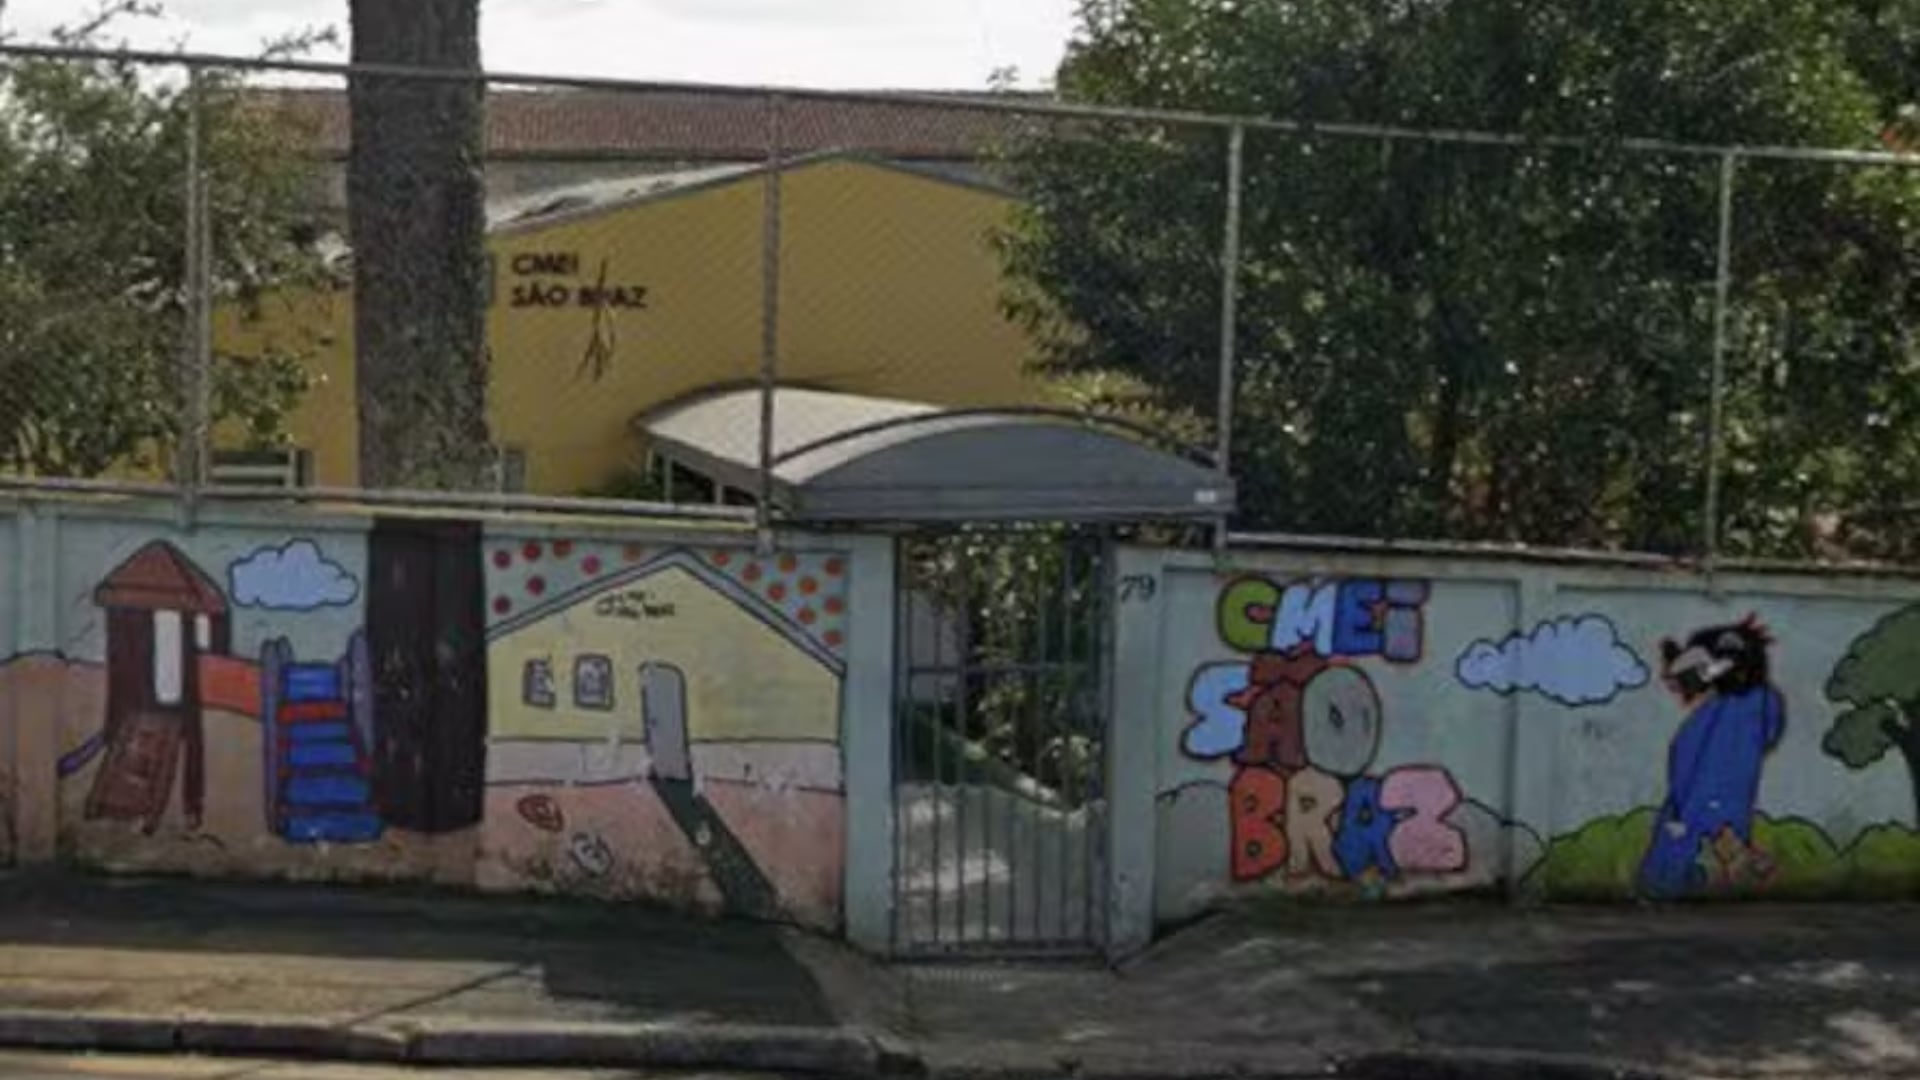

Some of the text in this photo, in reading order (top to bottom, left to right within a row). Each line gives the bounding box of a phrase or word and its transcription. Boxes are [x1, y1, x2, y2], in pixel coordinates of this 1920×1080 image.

[511, 253, 580, 275] CMEI
[510, 282, 568, 308] SÃO
[1119, 572, 1156, 604] 79
[1180, 650, 1383, 779] SÃO
[1228, 763, 1470, 881] BRAZ
